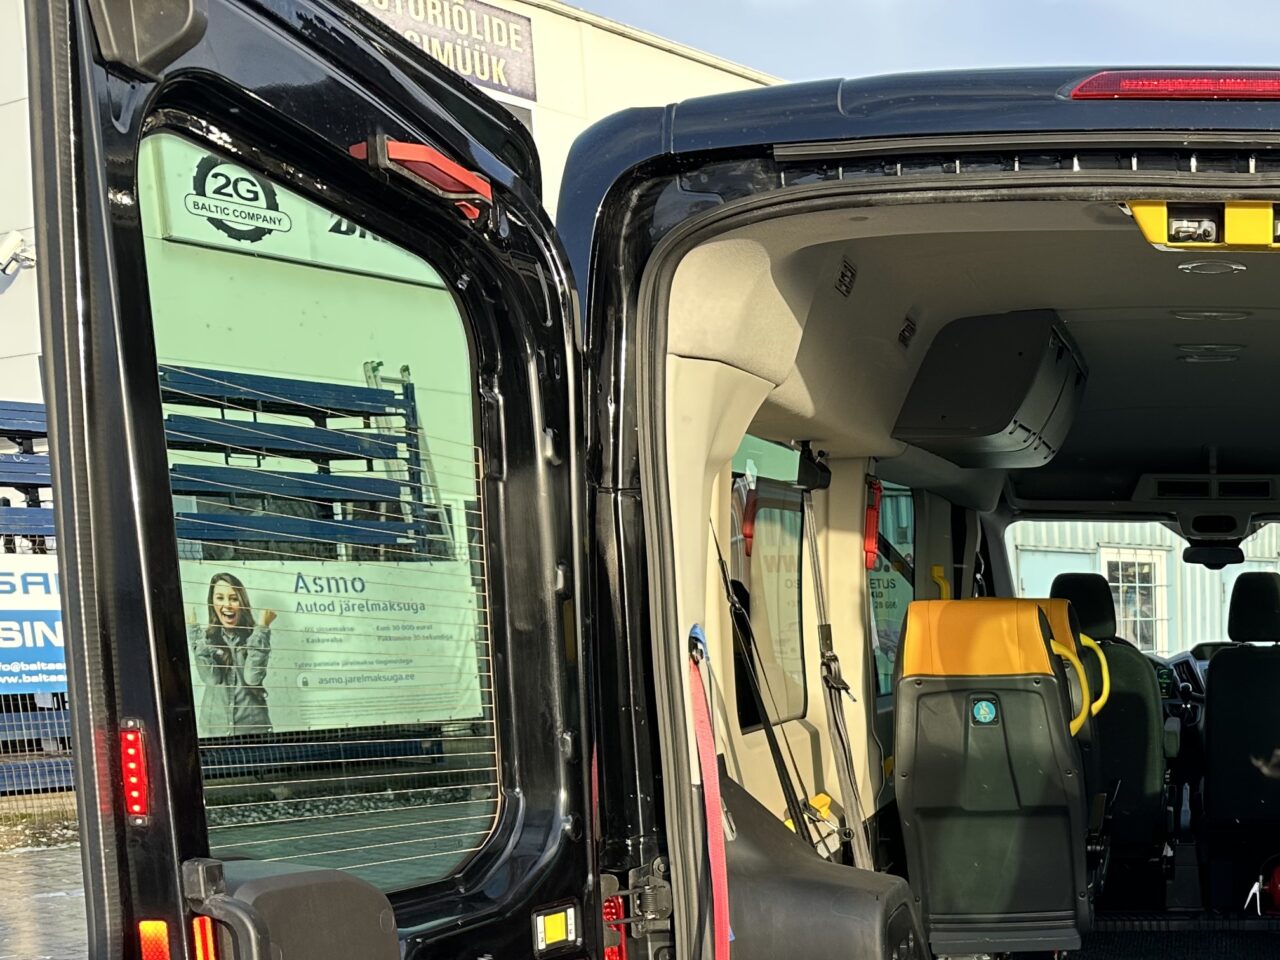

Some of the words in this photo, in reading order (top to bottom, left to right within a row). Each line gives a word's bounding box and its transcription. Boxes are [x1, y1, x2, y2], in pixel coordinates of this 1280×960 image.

[360, 0, 523, 53] ORIÕLIDE
[210, 172, 260, 202] 2G
[193, 201, 230, 217] BALTIC
[232, 208, 282, 226] COMPANY
[0, 572, 60, 595] SA
[294, 572, 366, 593] Asmo
[870, 579, 896, 589] ETUS
[295, 601, 335, 613] Autod
[339, 600, 426, 615] järelmaksuga
[318, 673, 415, 686] asmo.jarelmaksuga.ee
